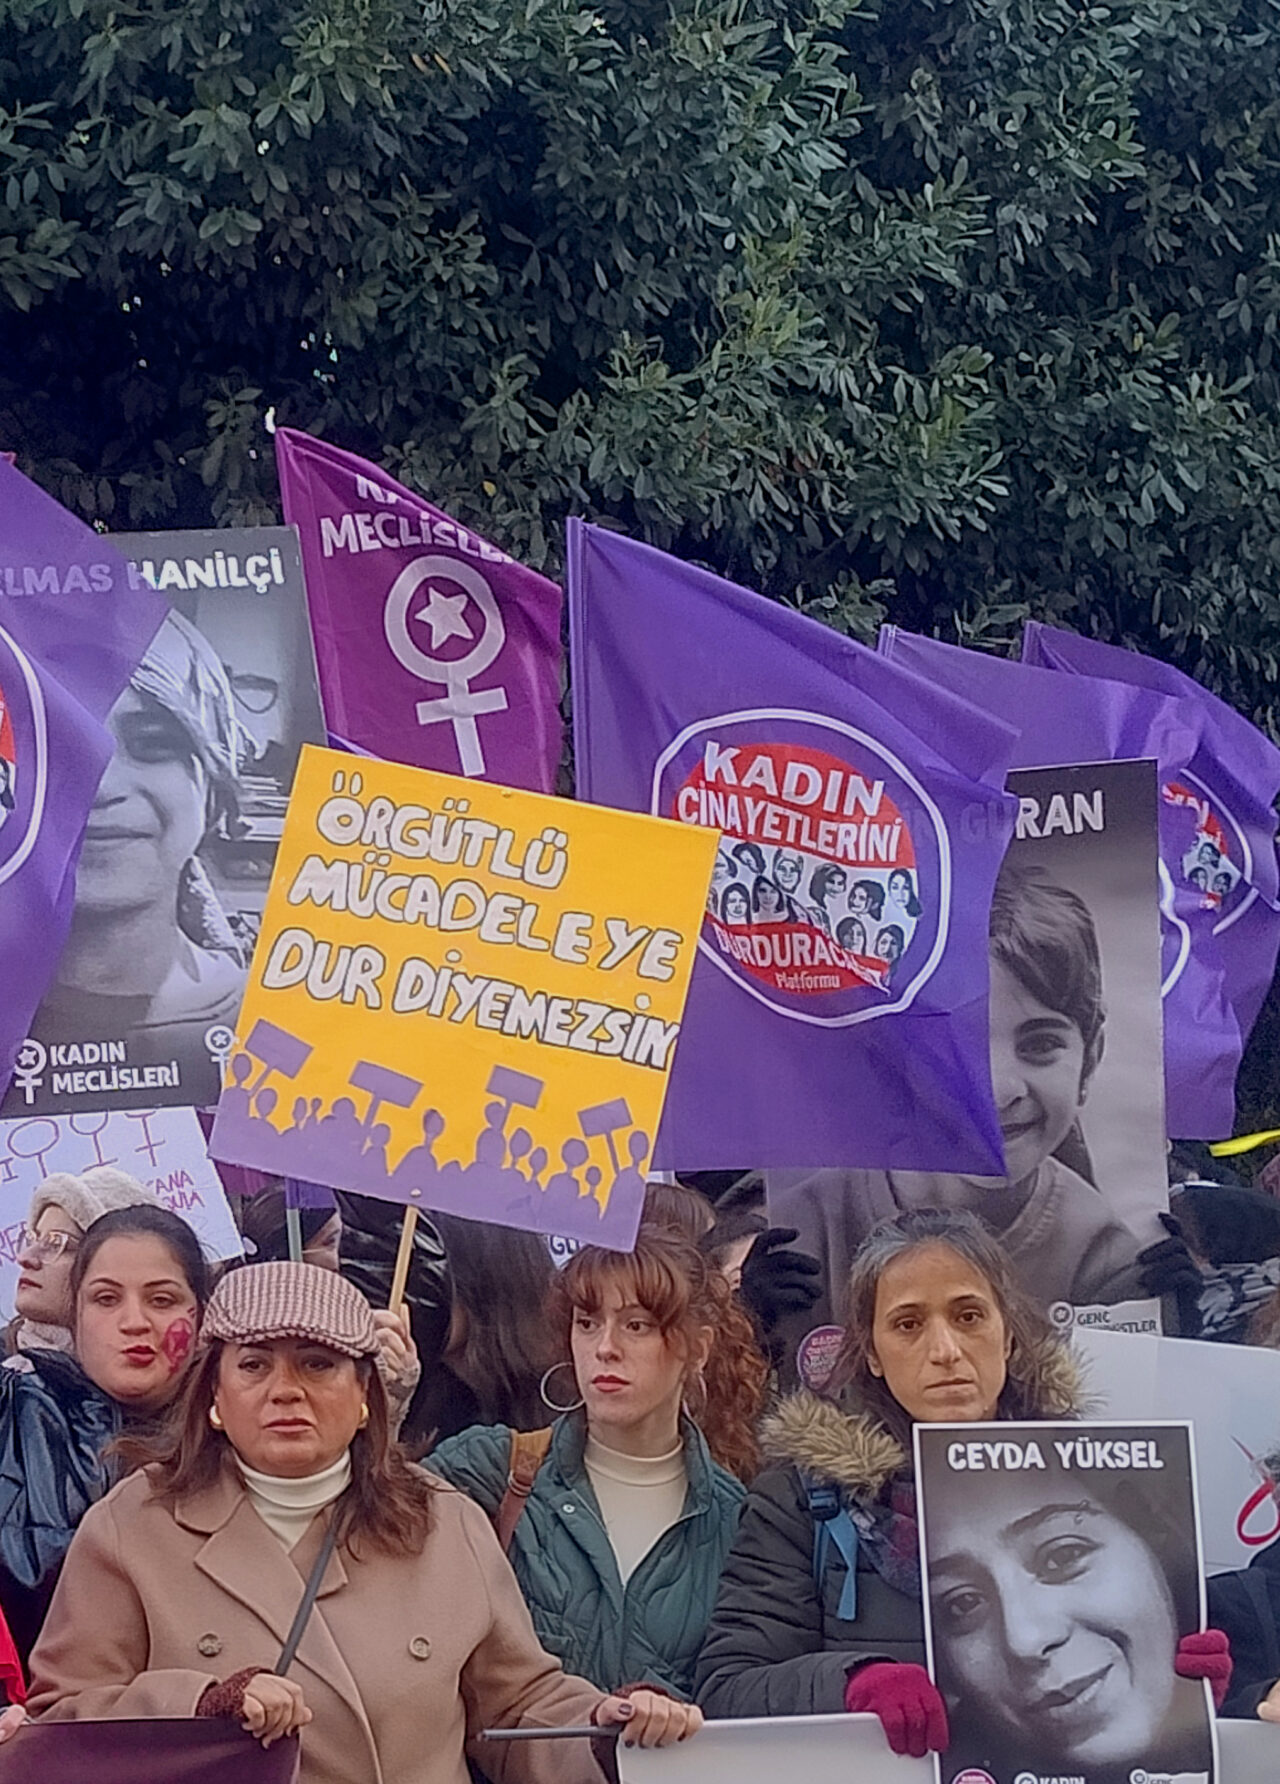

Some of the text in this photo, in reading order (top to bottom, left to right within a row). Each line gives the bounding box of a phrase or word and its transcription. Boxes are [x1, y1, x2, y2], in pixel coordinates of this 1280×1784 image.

[320, 512, 514, 565] MECLİSLE
[704, 740, 884, 817] KADIN
[317, 770, 569, 889] ÖRGÜTLÜ
[677, 780, 903, 863] CİNAYETLERİNİ
[262, 927, 681, 1071] DUR DİYEMEZSİN
[50, 1040, 126, 1067] KADIN
[52, 1060, 180, 1095] MECLİSLERİ
[947, 1437, 1165, 1471] CEYDA YÜKSEL
